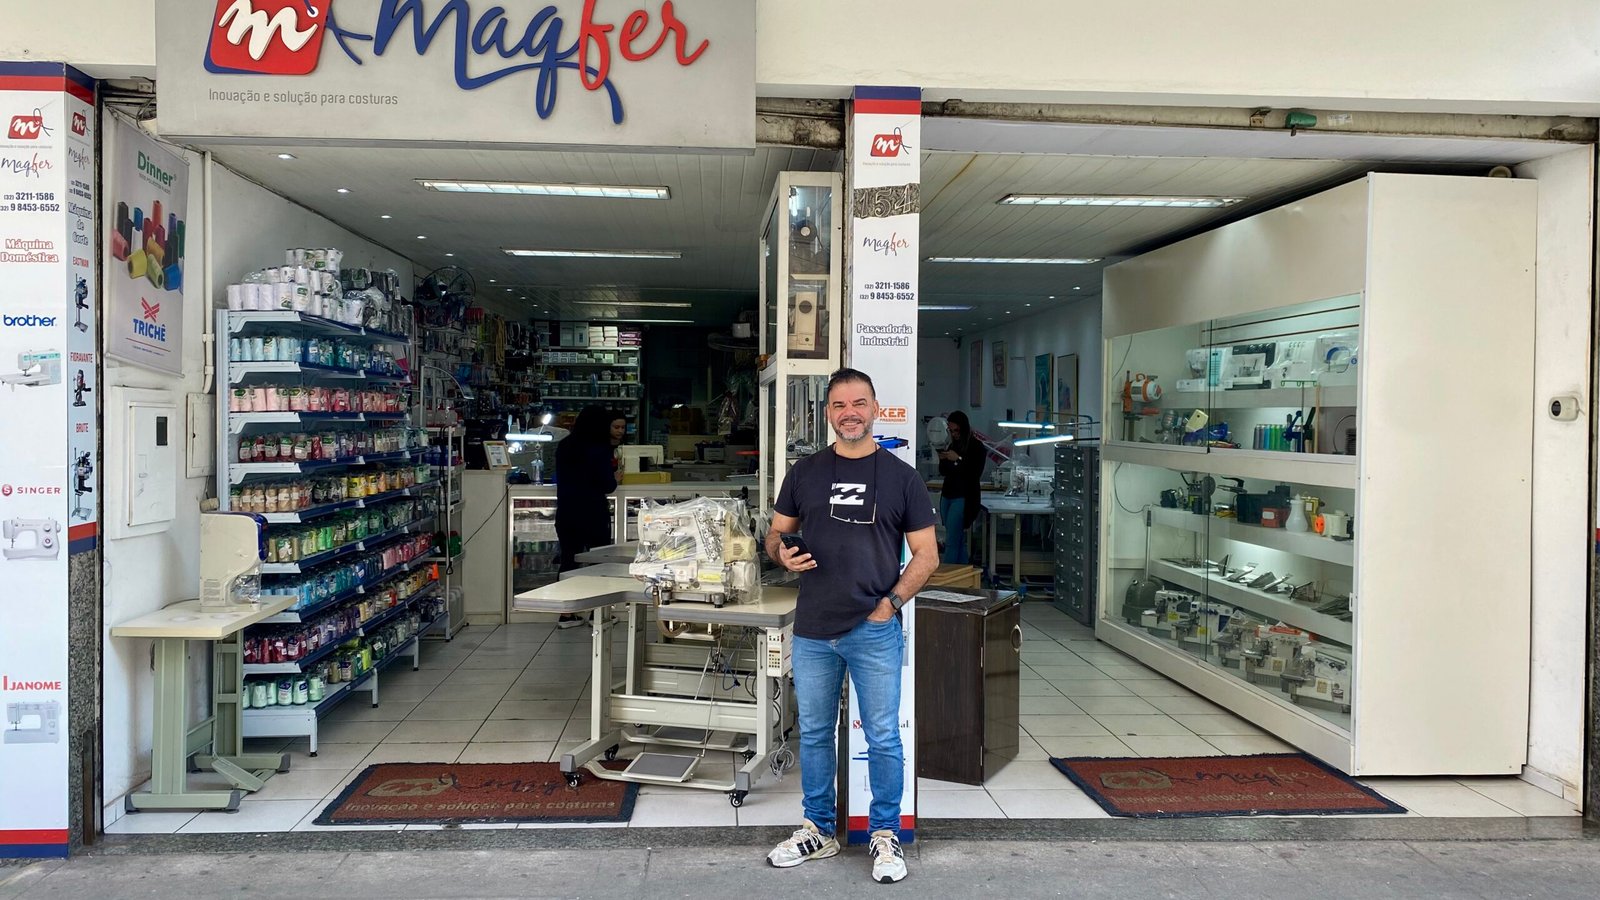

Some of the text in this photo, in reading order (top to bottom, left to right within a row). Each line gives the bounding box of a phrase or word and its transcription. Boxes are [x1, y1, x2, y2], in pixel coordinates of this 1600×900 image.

[263, 92, 271, 102] e
[273, 90, 318, 106] solução
[320, 92, 346, 106] para
[348, 93, 399, 105] costuras
[137, 150, 174, 187] Dinner
[15, 192, 55, 201] 3211-1586
[10, 203, 16, 211] 9
[17, 203, 60, 212] 8453-6552
[5, 238, 54, 251] Máquina
[0, 251, 60, 263] Doméstica
[875, 281, 910, 290] 3211-1586
[870, 292, 875, 300] 9
[876, 292, 915, 300] 8453-6552
[3, 314, 57, 327] brother
[133, 318, 166, 342] TRICHÊ
[856, 323, 913, 335] Passadoria
[860, 335, 909, 347] Industrial
[17, 486, 61, 494] SINGER
[8, 681, 62, 690] JANOME
